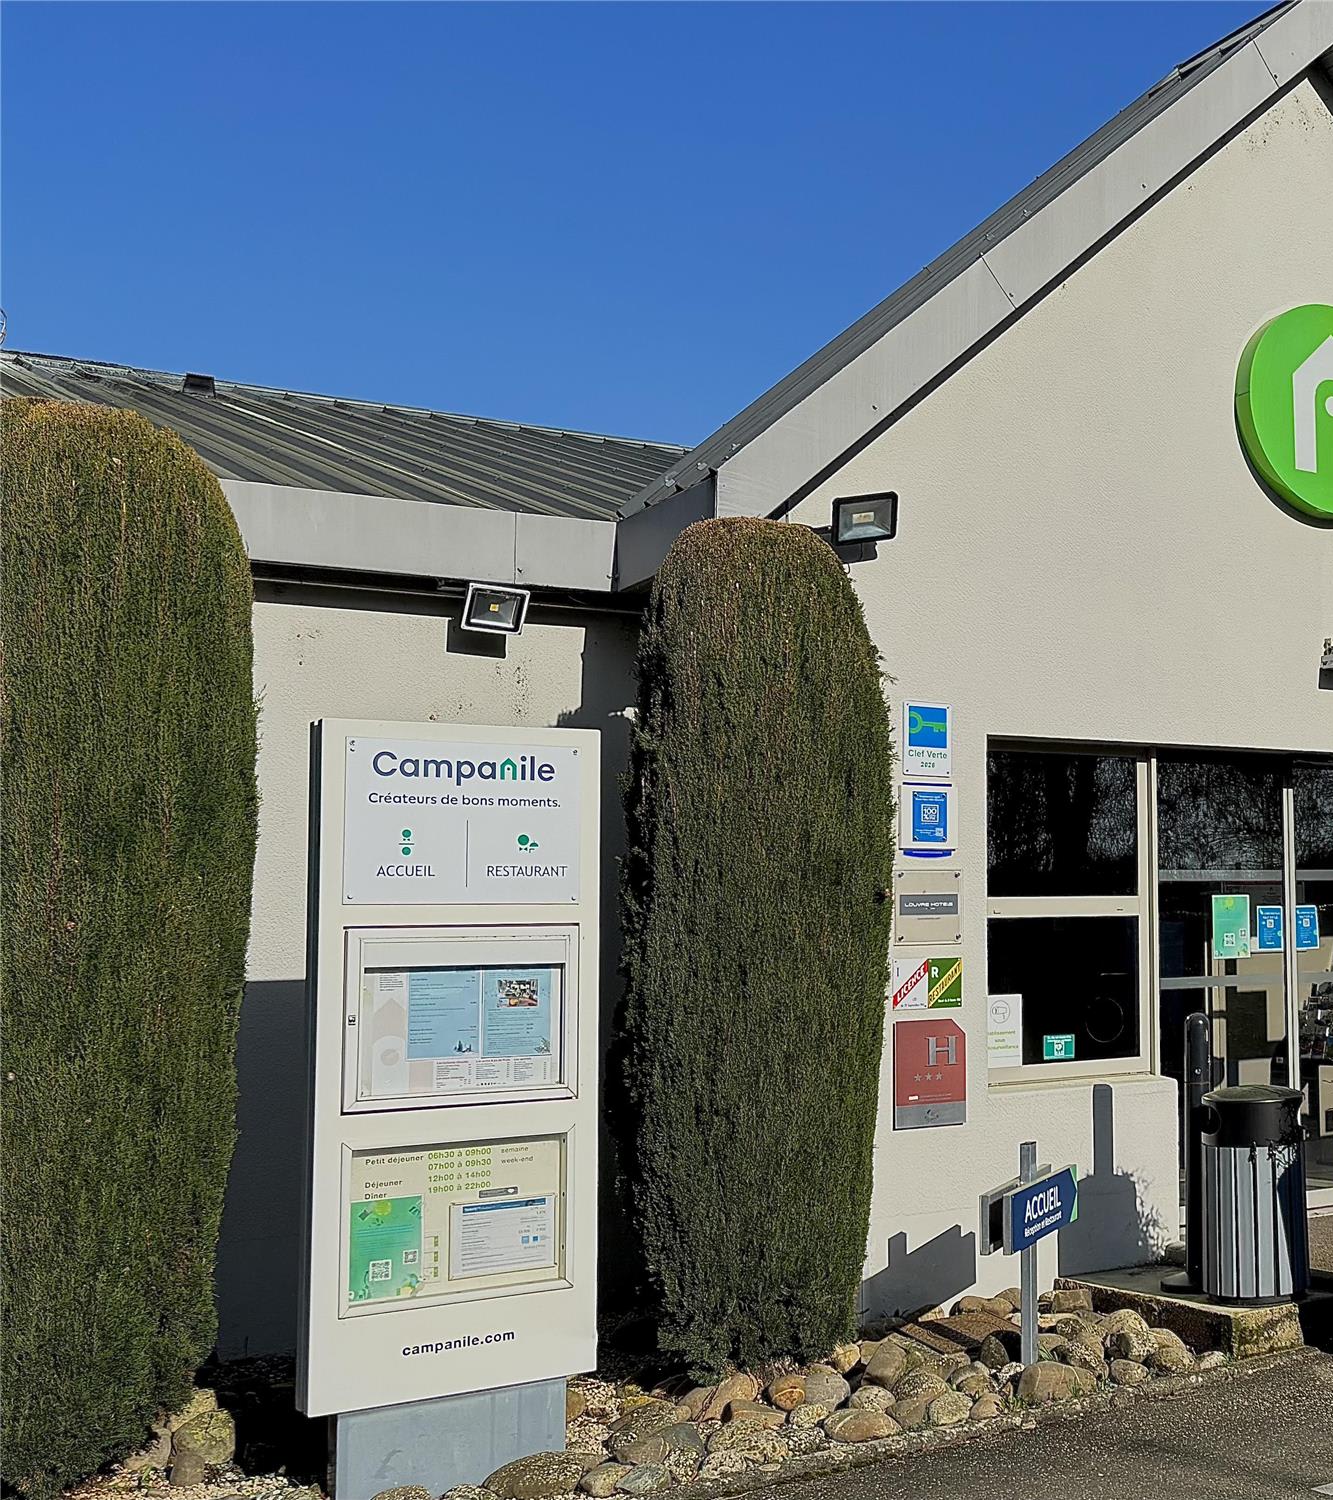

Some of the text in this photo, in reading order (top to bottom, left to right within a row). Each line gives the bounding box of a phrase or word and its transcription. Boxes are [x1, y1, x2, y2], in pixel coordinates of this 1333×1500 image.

[908, 749, 948, 759] Clef Verte
[372, 751, 556, 786] Campanile
[368, 792, 561, 808] Créateurs de bons moments.
[376, 865, 435, 877] ACCUEIL
[486, 865, 568, 877] RESTAURANT
[931, 966, 939, 978] R
[896, 963, 926, 1003] LICENCE
[924, 1035, 960, 1067] H
[465, 1148, 492, 1156] 09h00
[388, 1155, 424, 1164] déjeuner
[428, 1161, 455, 1171] 07h00
[465, 1158, 492, 1167] 09h30
[428, 1173, 455, 1182] 12h00
[364, 1180, 403, 1189] Déjeuner
[464, 1181, 491, 1190] 22h00
[1024, 1185, 1062, 1224] ACCUEIL
[402, 1331, 515, 1356] campanile.com
